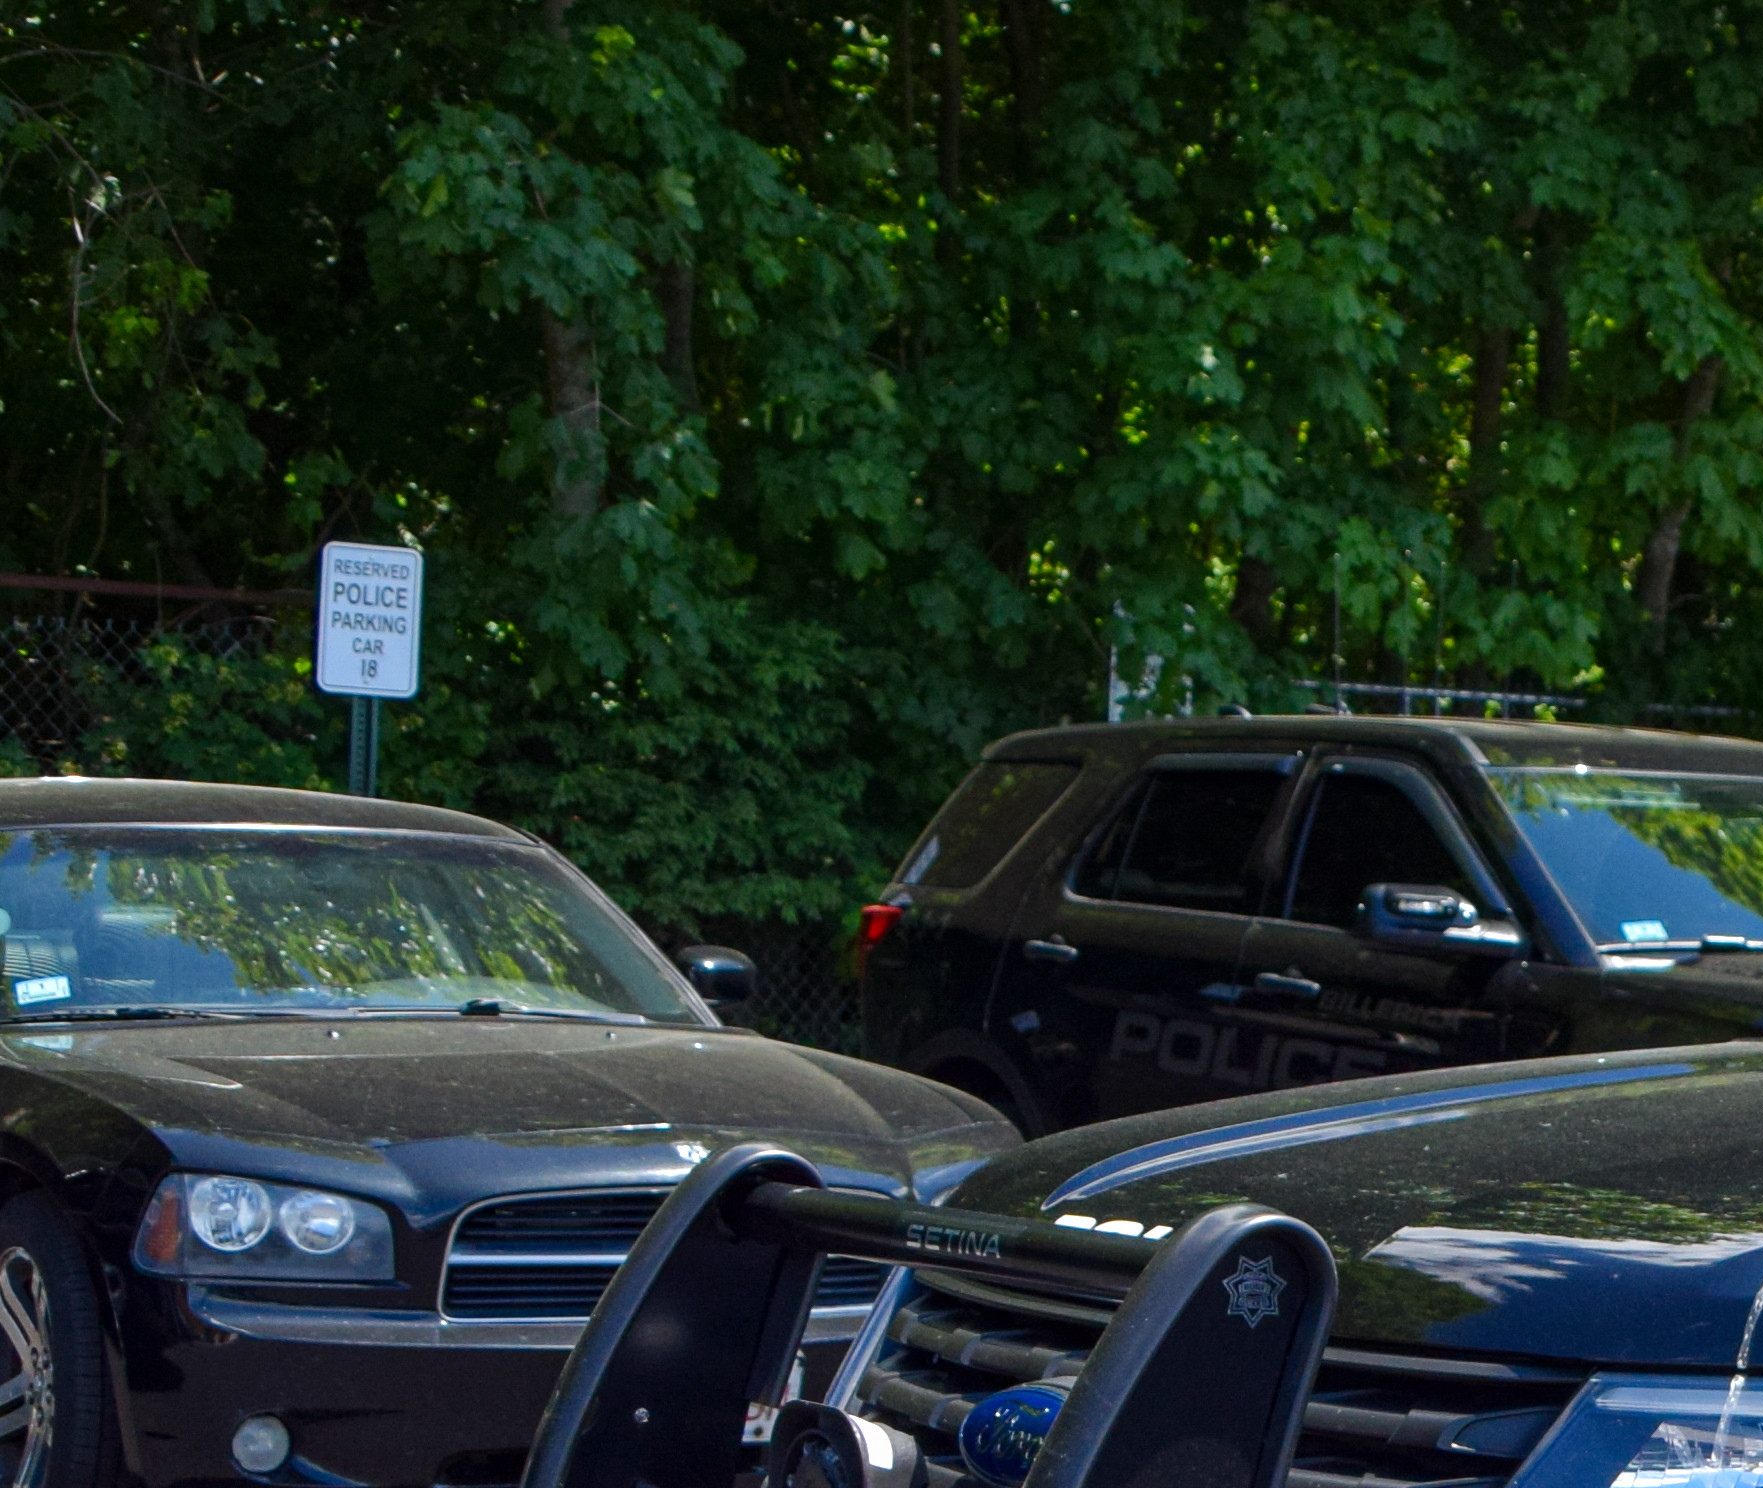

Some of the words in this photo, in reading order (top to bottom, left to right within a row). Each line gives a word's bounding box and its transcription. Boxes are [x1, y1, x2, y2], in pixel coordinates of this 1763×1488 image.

[333, 558, 409, 580] RESERVED
[332, 581, 408, 609] POLICE
[331, 610, 406, 635] PARKING
[352, 637, 384, 655] CAR
[360, 658, 378, 678] 18
[1110, 1009, 1387, 1090] POLICE
[906, 1223, 1001, 1259] SETINA
